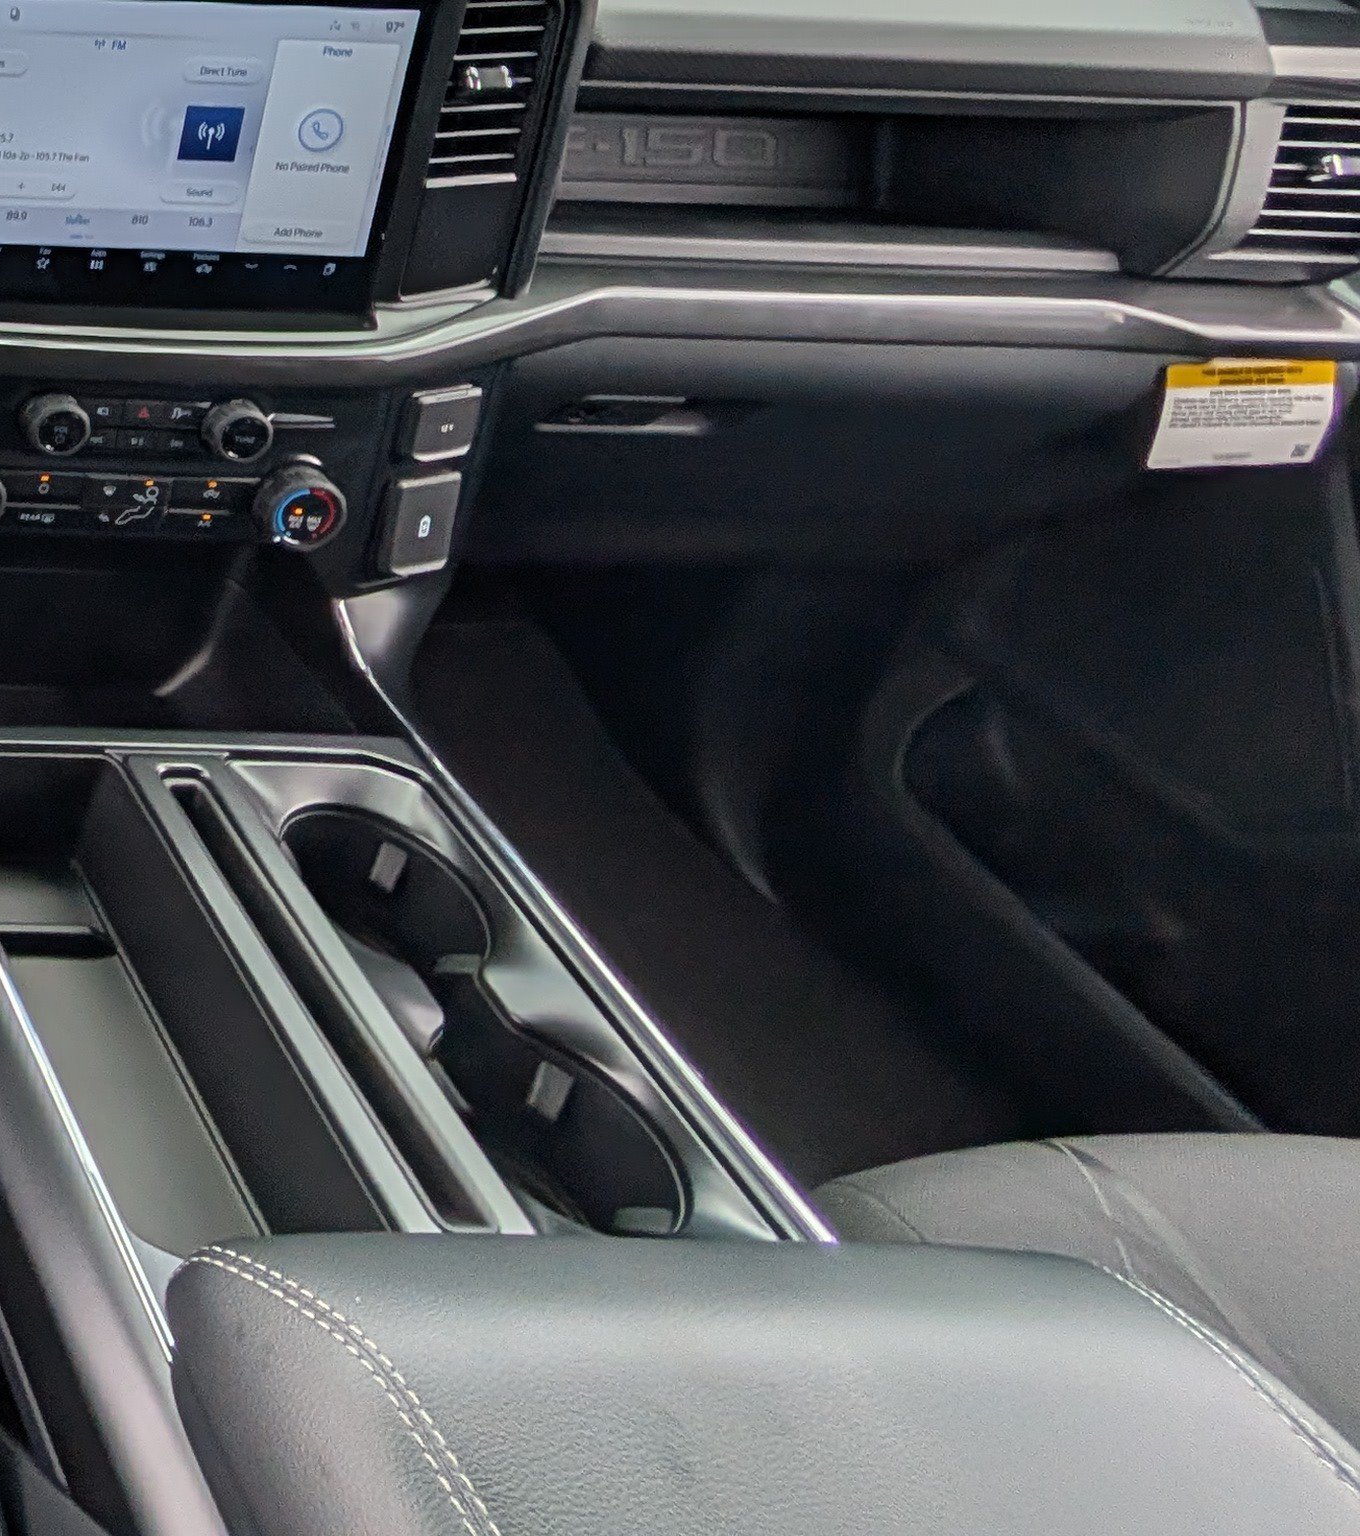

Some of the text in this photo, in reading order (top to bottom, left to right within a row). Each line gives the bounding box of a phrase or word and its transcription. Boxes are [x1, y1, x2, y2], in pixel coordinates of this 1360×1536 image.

[111, 40, 127, 51] FM
[322, 45, 354, 57] Phone
[200, 65, 248, 77] Direct Tune
[58, 152, 75, 162] The
[274, 161, 351, 174] No Paired Phone
[186, 188, 214, 198] Sound
[273, 227, 324, 238] Add Phone
